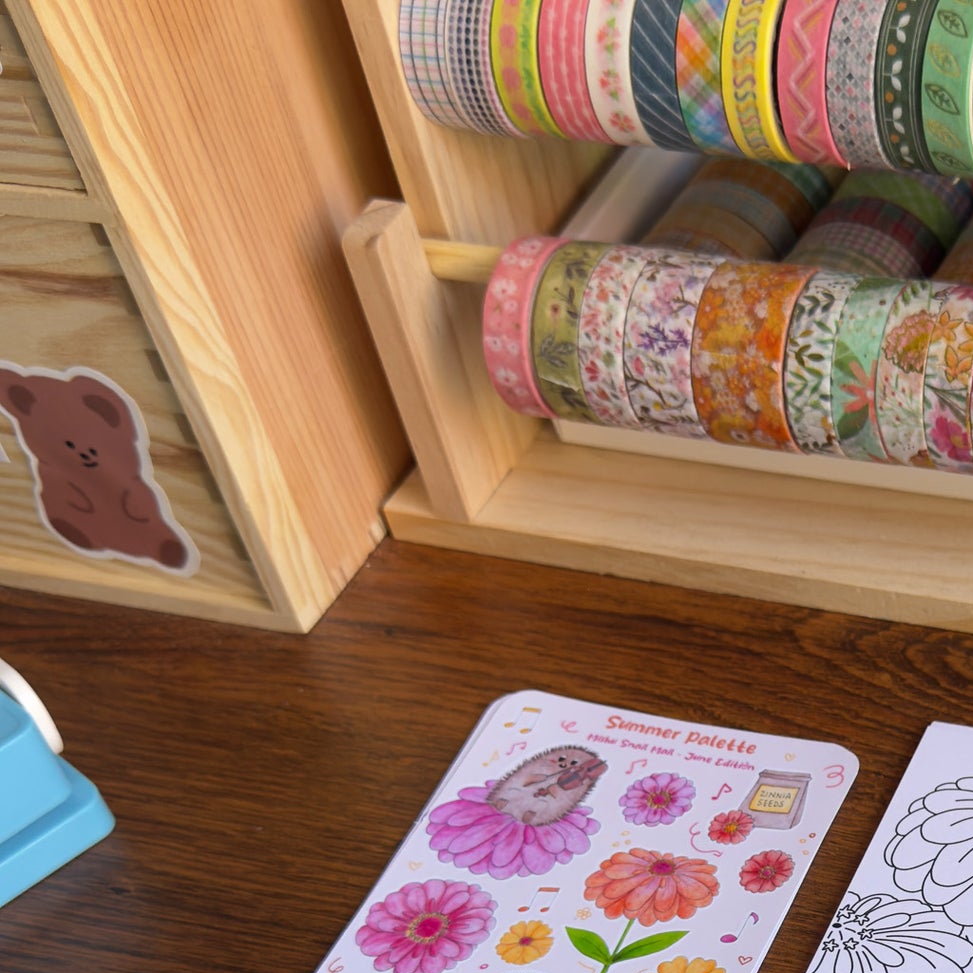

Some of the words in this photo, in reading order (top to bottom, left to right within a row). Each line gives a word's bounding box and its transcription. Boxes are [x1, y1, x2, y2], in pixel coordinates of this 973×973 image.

[605, 715, 681, 740] Summer
[685, 731, 757, 755] Palette
[621, 739, 648, 751] Snail
[650, 744, 674, 757] Mail
[685, 752, 712, 765] June
[714, 758, 755, 772] Edition
[757, 799, 785, 808] SEEDS
[760, 790, 792, 801] ZINNIA
